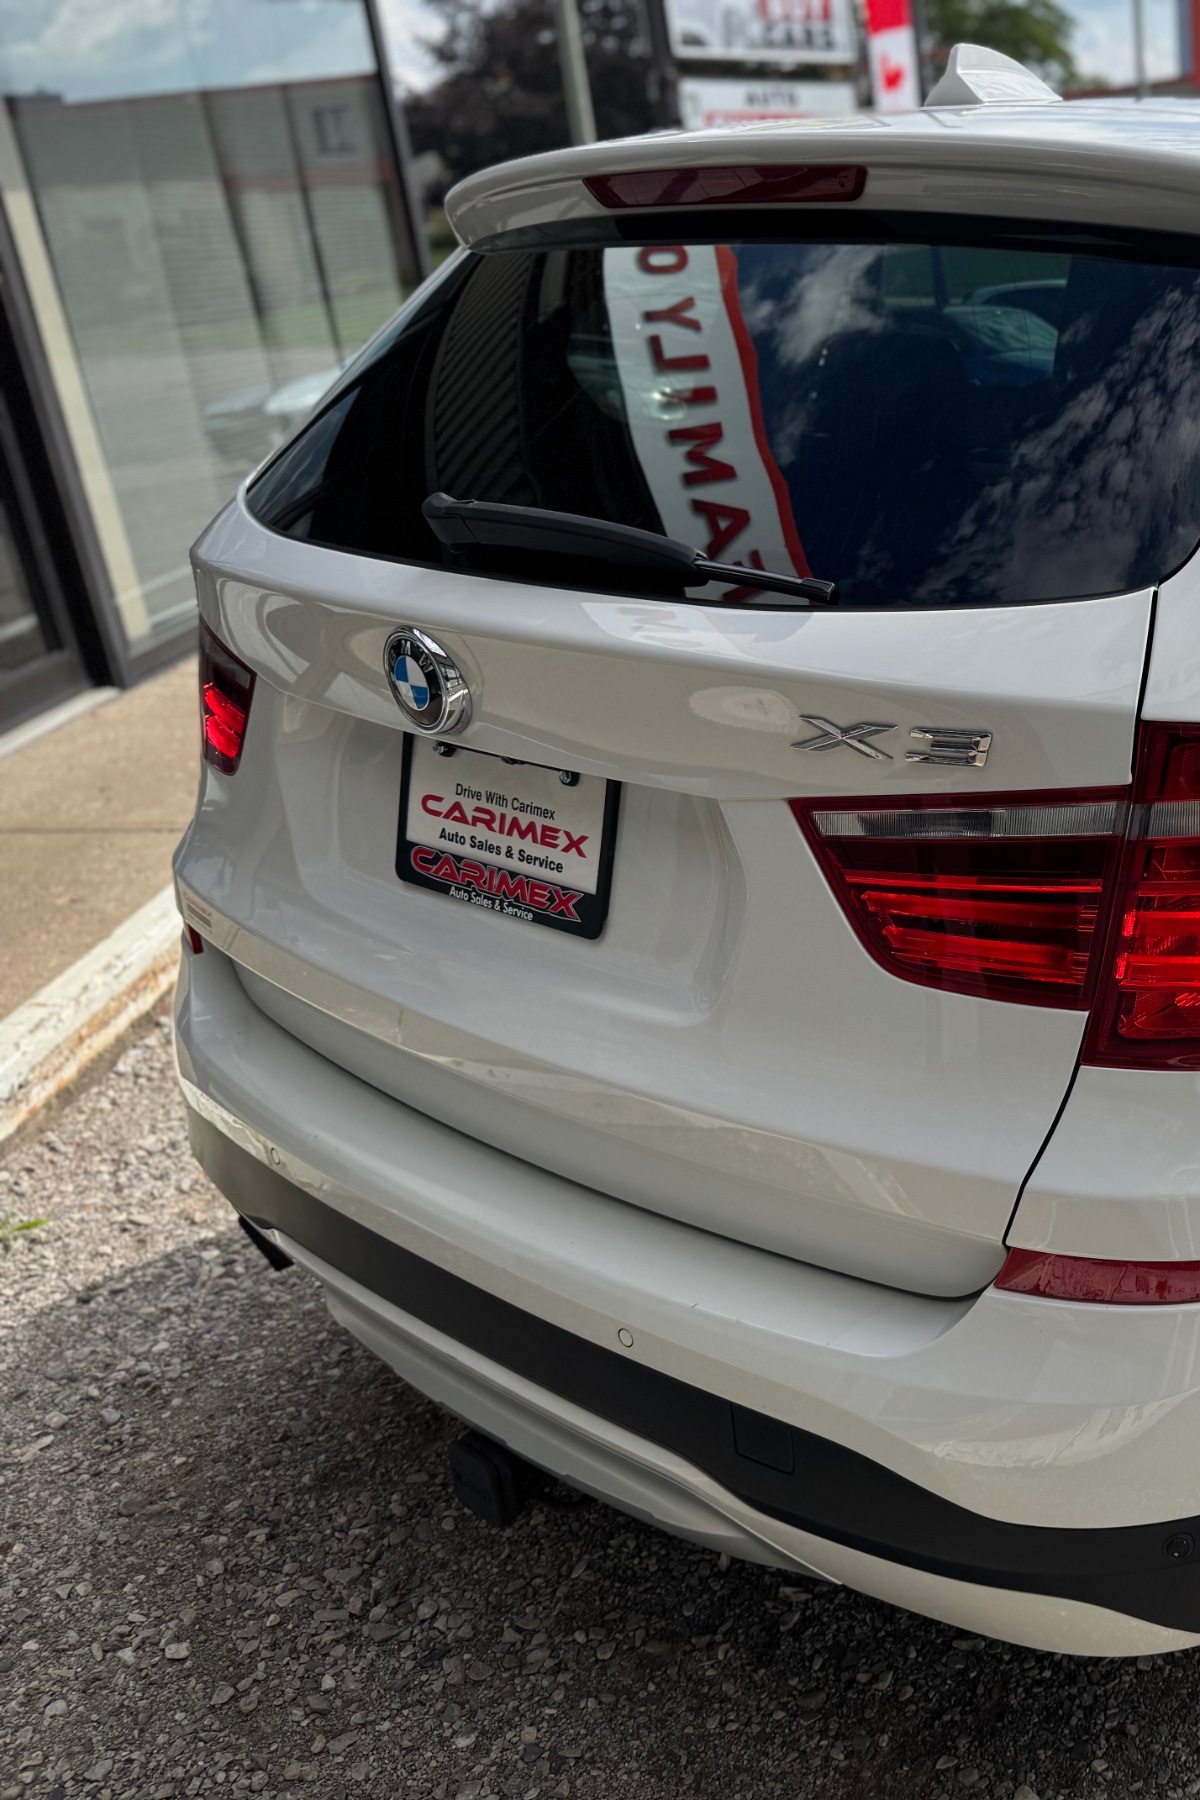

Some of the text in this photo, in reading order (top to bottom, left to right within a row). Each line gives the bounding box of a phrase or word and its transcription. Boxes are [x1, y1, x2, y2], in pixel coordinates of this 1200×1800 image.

[790, 714, 993, 767] X3
[421, 794, 589, 858] CARIMEX
[455, 783, 556, 820] Drive With Carimex
[439, 827, 563, 873] Auto Sales & Service
[411, 846, 584, 922] CARIMEX
[449, 885, 534, 921] Auto Sales & Service
